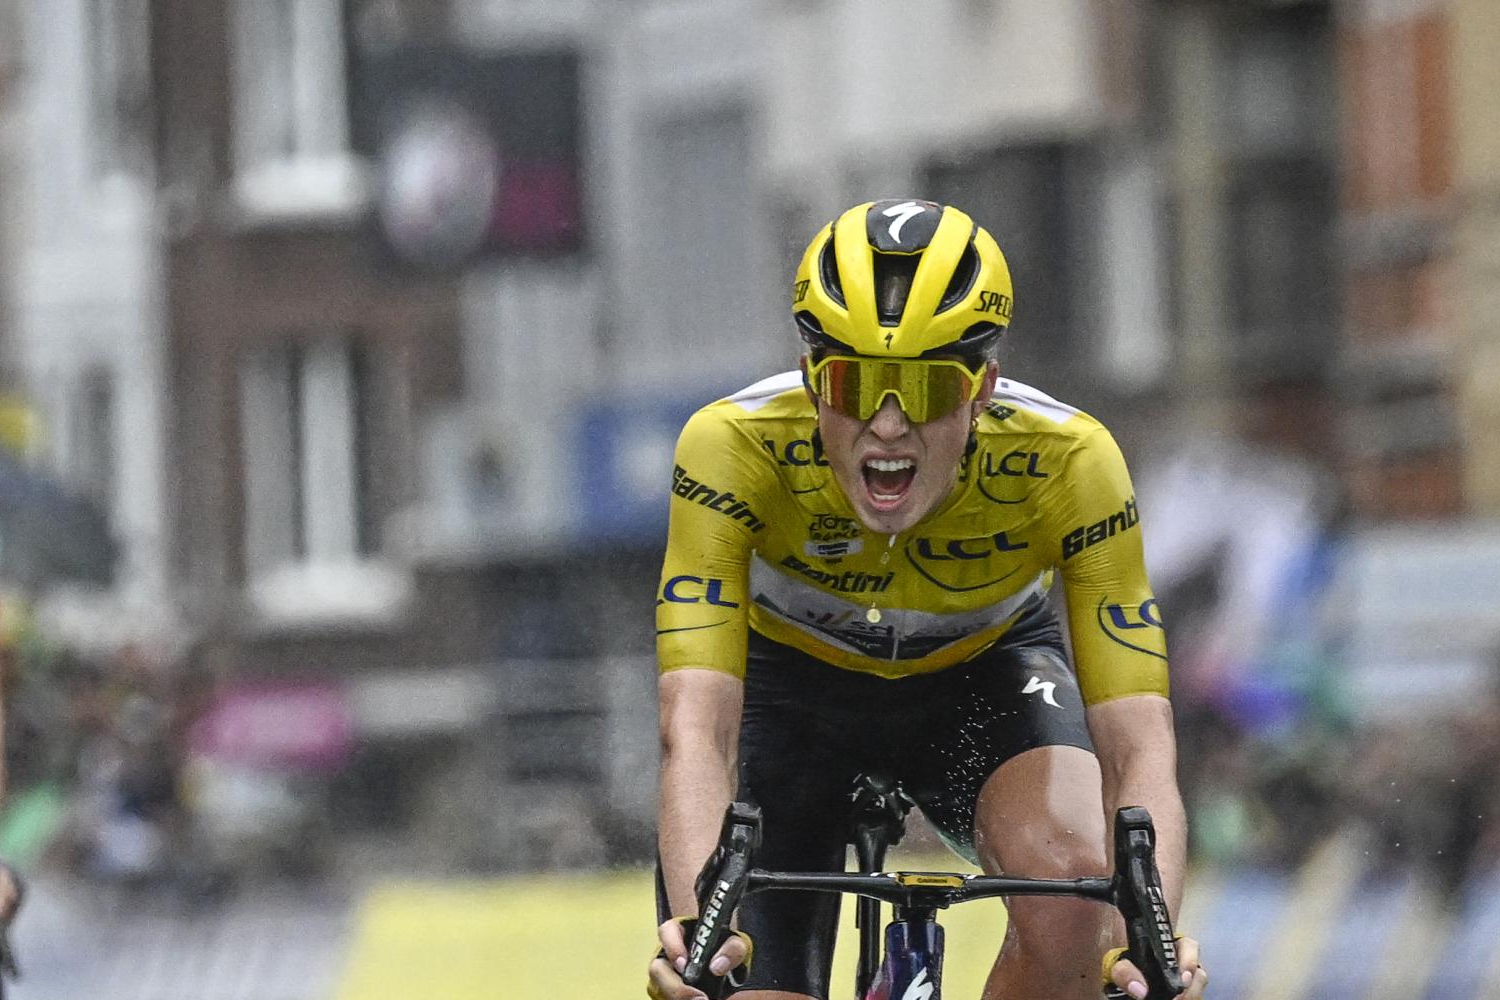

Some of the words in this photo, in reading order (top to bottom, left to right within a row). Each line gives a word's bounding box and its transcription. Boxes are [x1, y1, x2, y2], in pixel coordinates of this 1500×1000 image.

[985, 450, 1049, 478] LCL
[671, 464, 766, 534] Santini
[915, 530, 1029, 561] LCL
[780, 554, 896, 593] Santini
[657, 575, 740, 609] CL
[693, 880, 731, 965] SRAM
